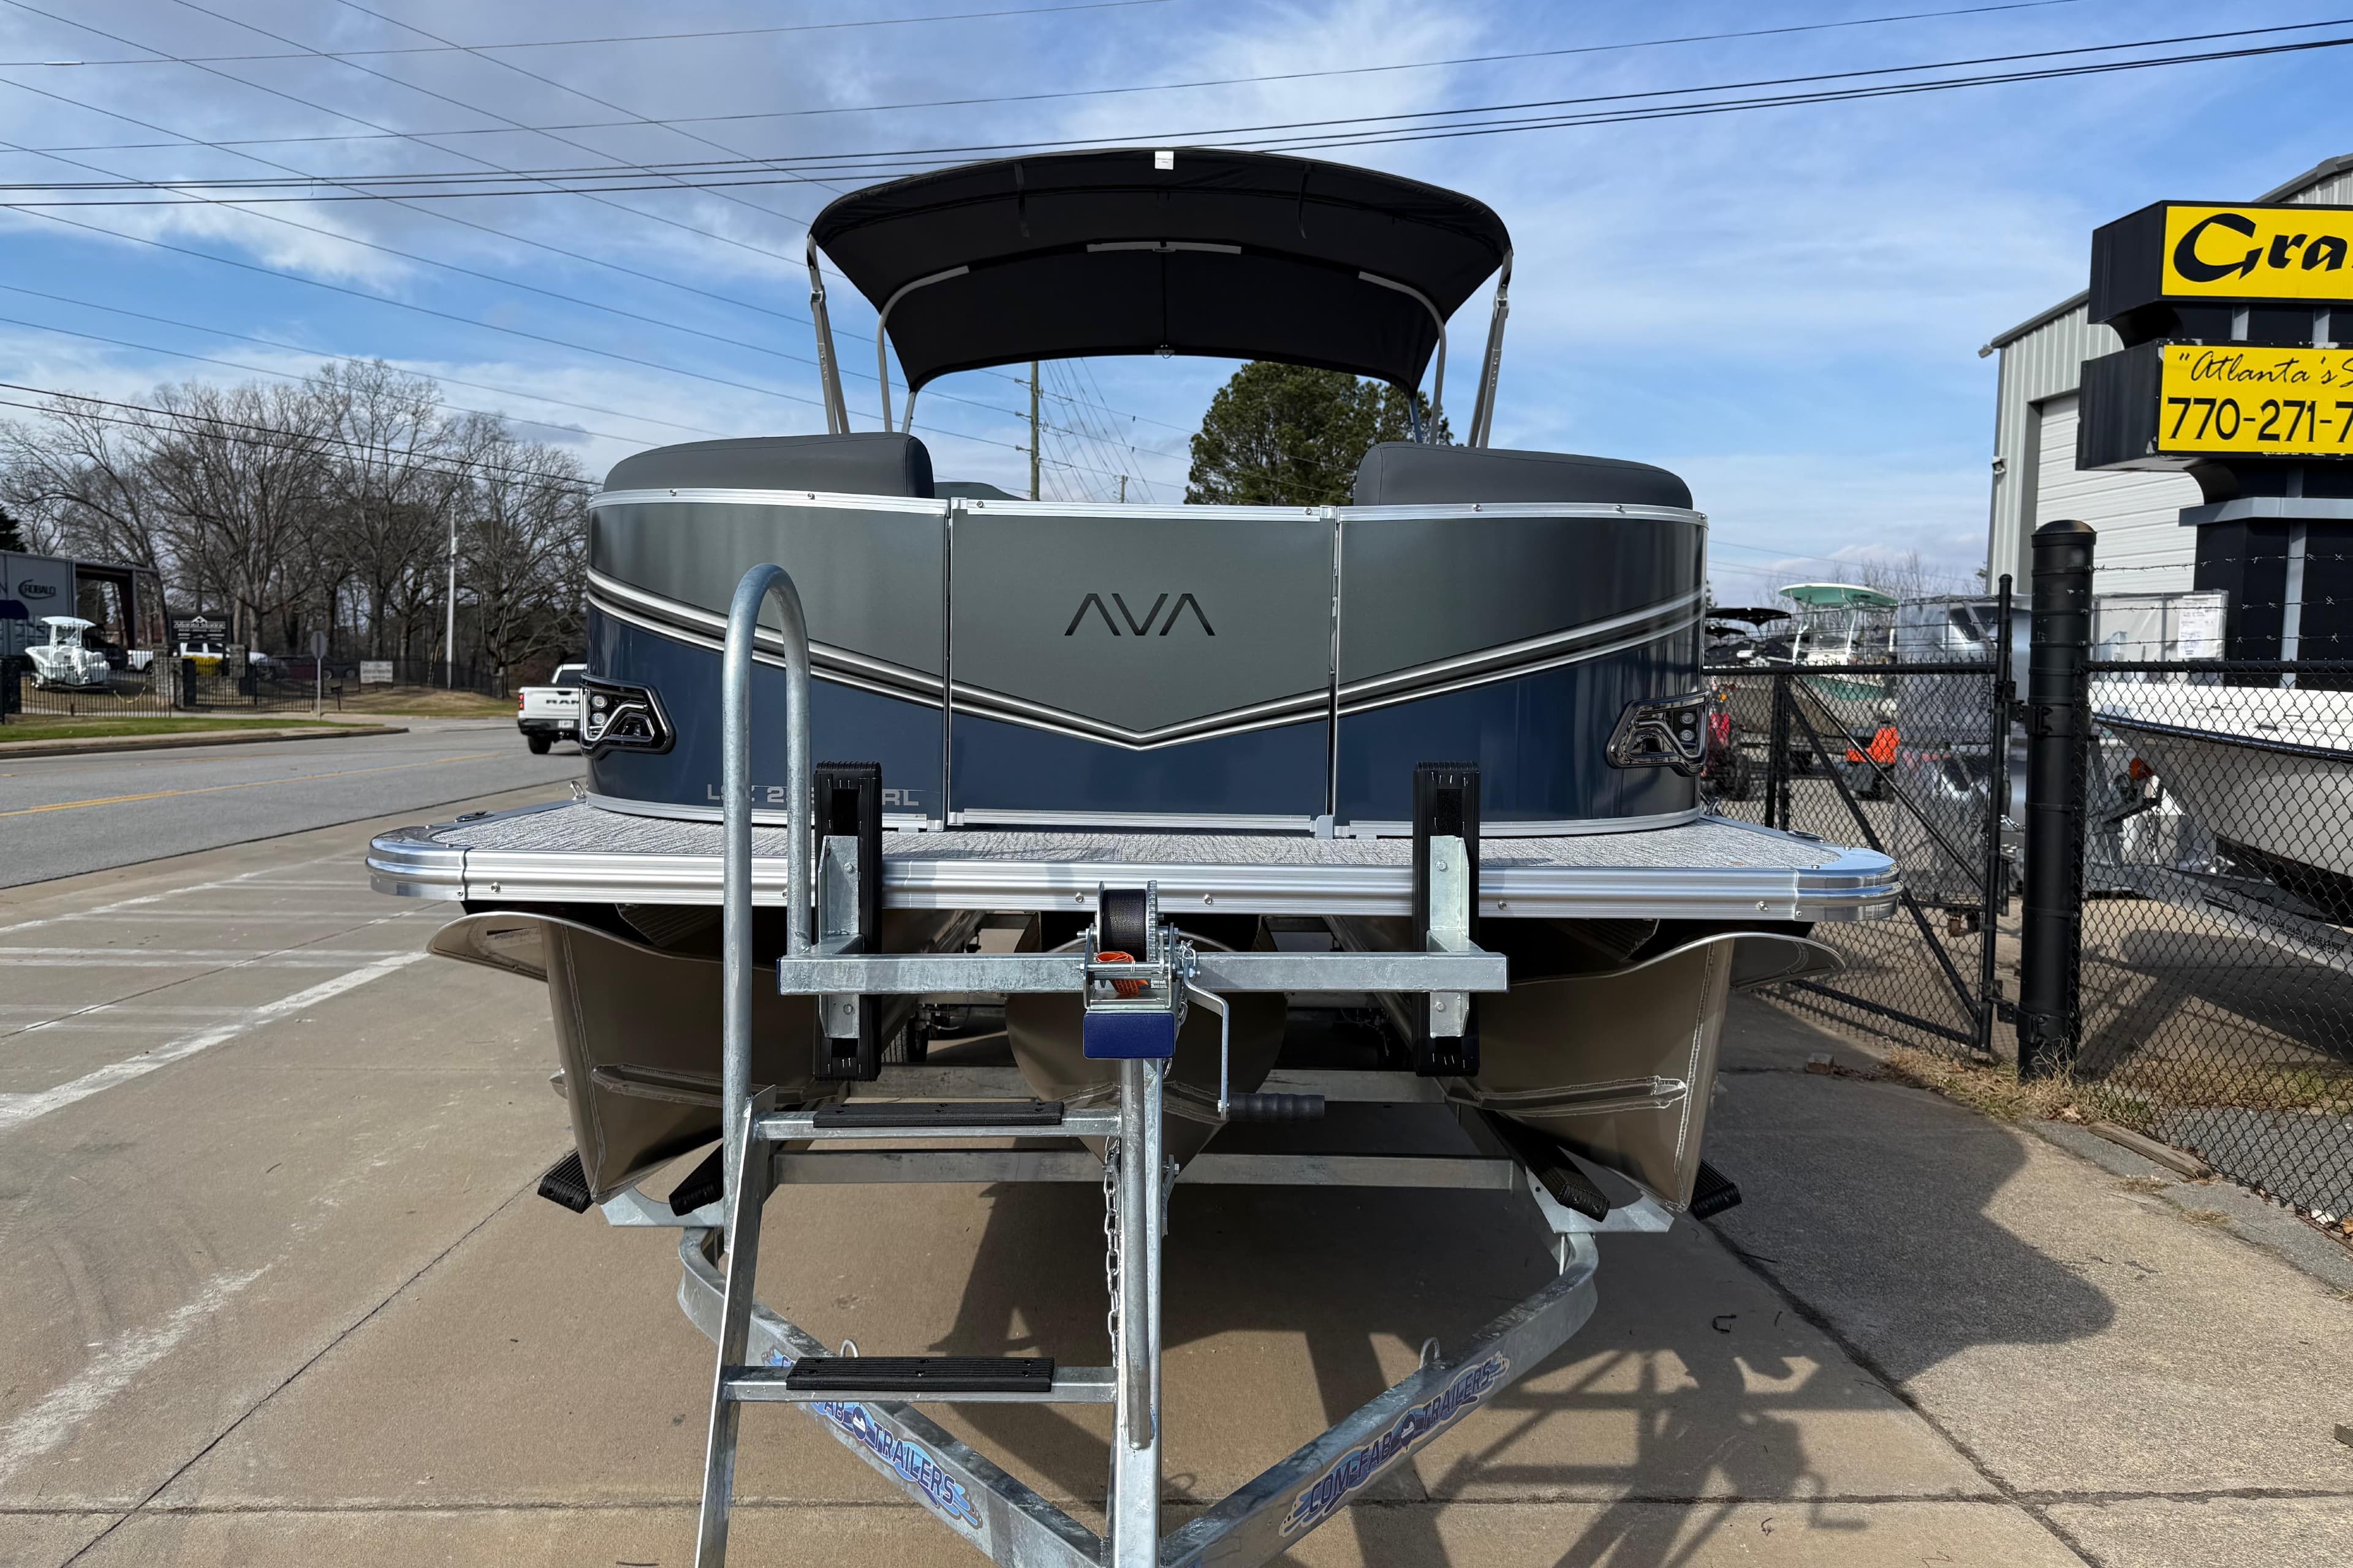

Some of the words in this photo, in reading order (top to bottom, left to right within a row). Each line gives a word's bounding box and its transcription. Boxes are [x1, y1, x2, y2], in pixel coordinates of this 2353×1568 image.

[1064, 593, 1216, 636] AVA
[874, 1421, 956, 1506] TRAILERS
[1309, 1431, 1392, 1514] COM-FAB
[1423, 1359, 1491, 1430] TRAILERS
